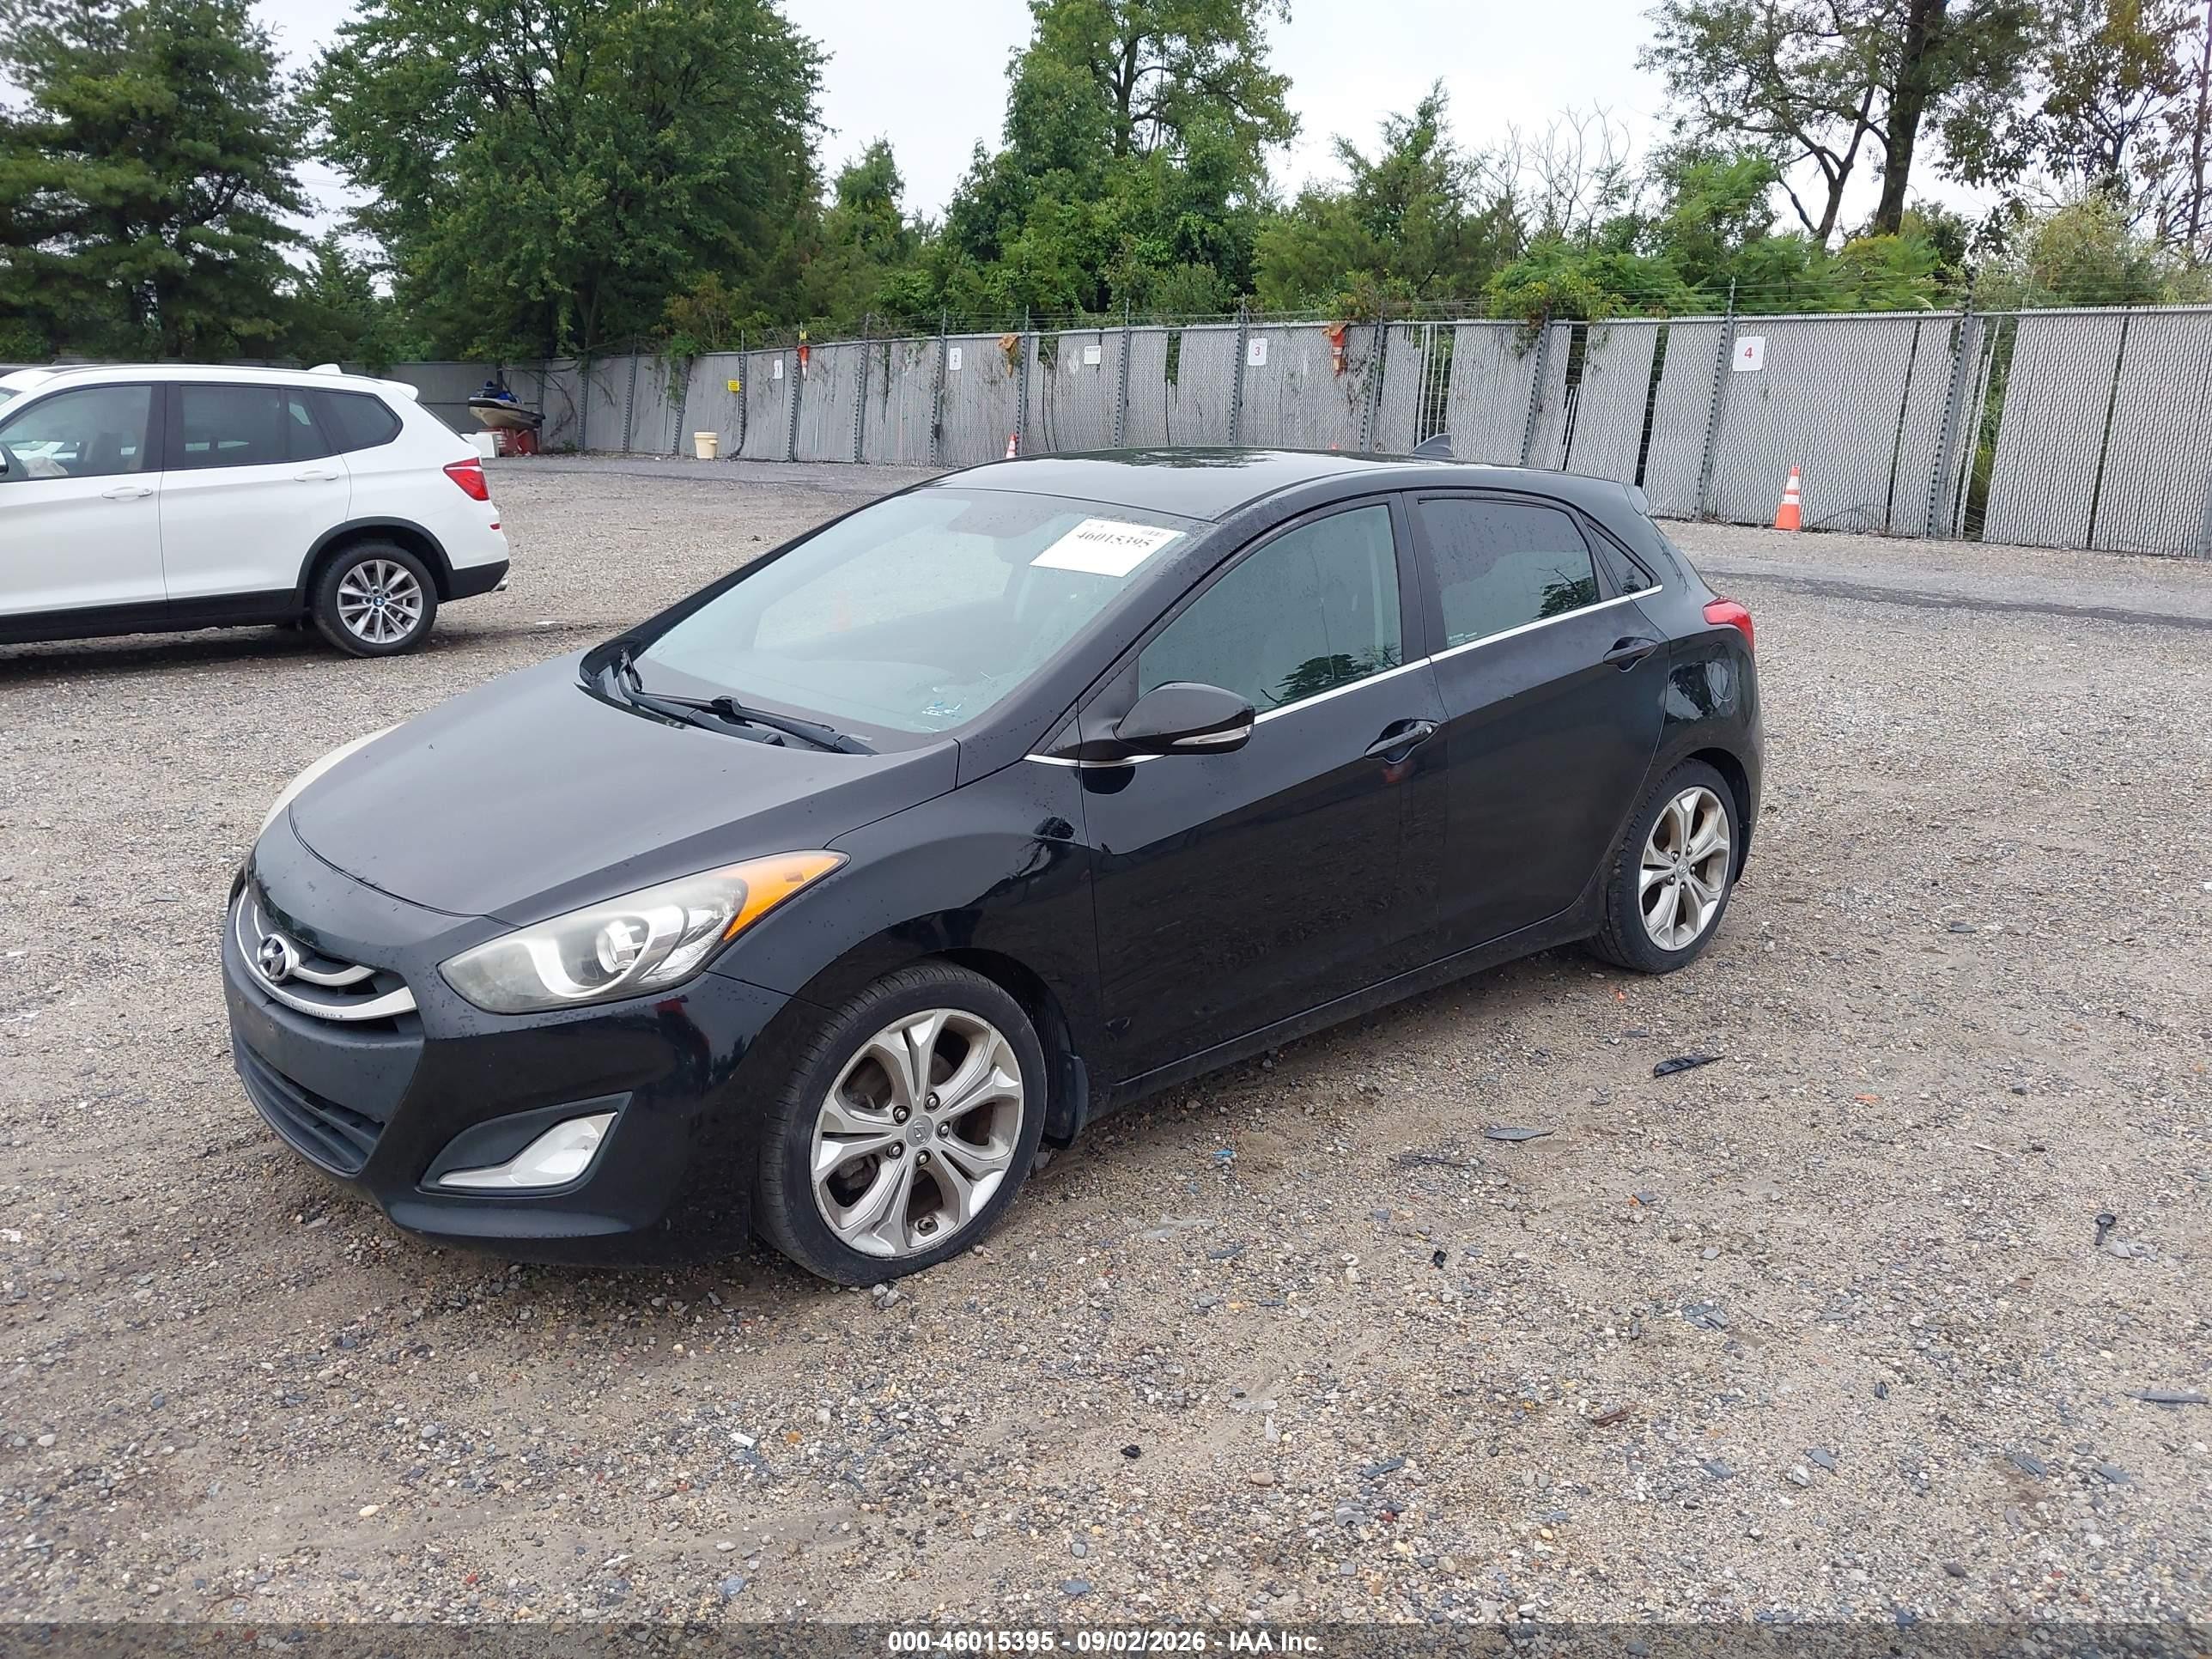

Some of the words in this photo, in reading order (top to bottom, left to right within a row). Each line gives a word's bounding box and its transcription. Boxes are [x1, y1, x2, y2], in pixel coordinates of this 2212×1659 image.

[1255, 346, 1261, 356] 3
[1744, 347, 1753, 359] 4
[1077, 531, 1154, 548] 46015395
